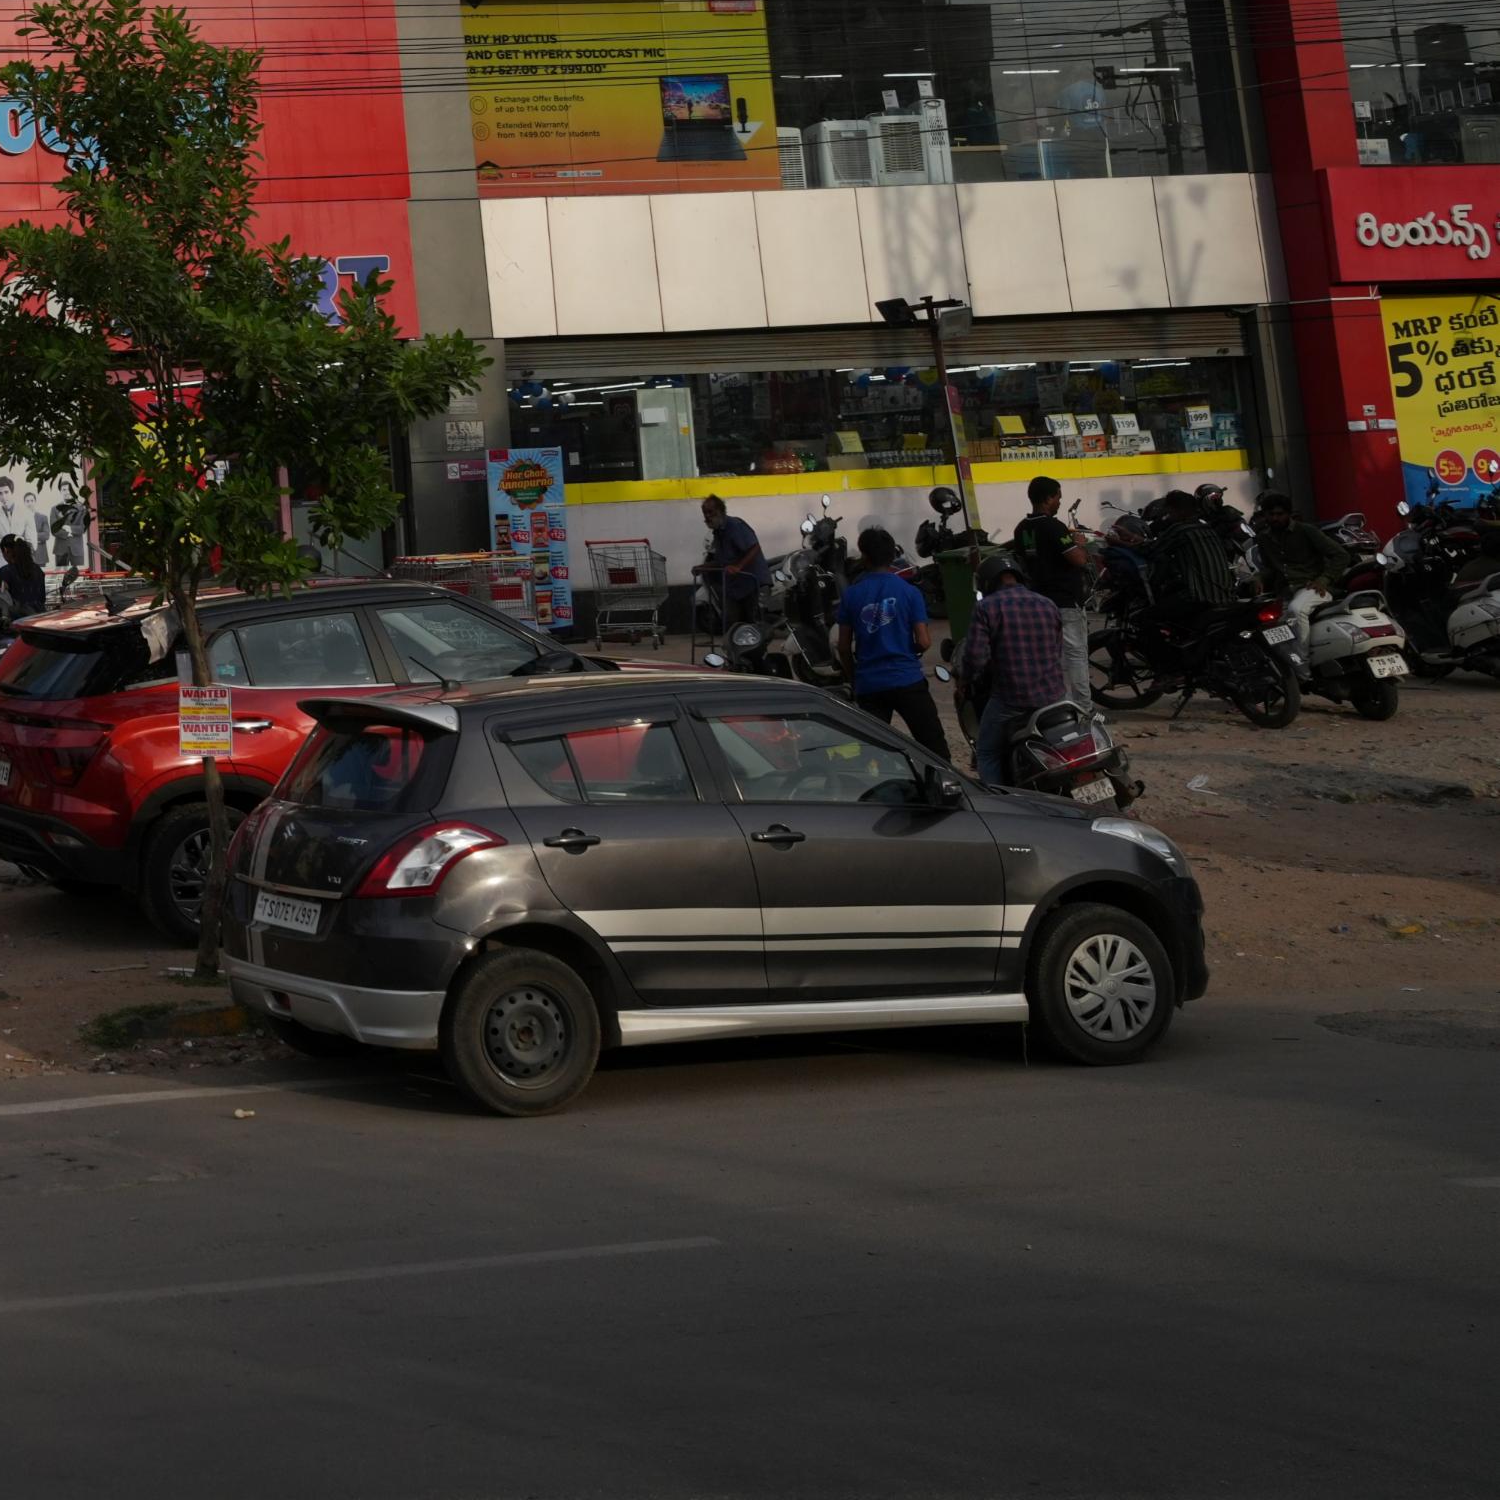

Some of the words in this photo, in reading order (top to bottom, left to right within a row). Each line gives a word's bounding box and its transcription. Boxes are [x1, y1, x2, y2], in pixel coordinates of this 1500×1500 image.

[465, 34, 490, 45] BUY
[493, 34, 510, 45] HP
[513, 33, 557, 44] VICTUS
[466, 49, 493, 60] AND
[496, 49, 520, 60] GET
[524, 49, 572, 59] HYPERX
[575, 47, 641, 59] SOLOCAST
[643, 47, 665, 58] MIC
[494, 95, 531, 104] Exchange
[532, 94, 551, 102] Offer
[553, 93, 584, 102] Benefits
[495, 104, 503, 112] of
[504, 105, 515, 113] up
[516, 104, 525, 112] to
[497, 121, 533, 129] Extended
[534, 120, 569, 130] Warranty
[497, 131, 516, 139] from
[568, 129, 600, 137] students
[1356, 204, 1491, 260] రిలయన్స్
[1392, 315, 1442, 340] MRP
[1188, 412, 1209, 422] 1999
[506, 469, 523, 480] Har
[524, 468, 545, 479] Ghar
[499, 478, 553, 491] Annapurna
[182, 689, 227, 698] WANTED
[183, 724, 229, 732] WANTED
[336, 835, 369, 846] SWIFT
